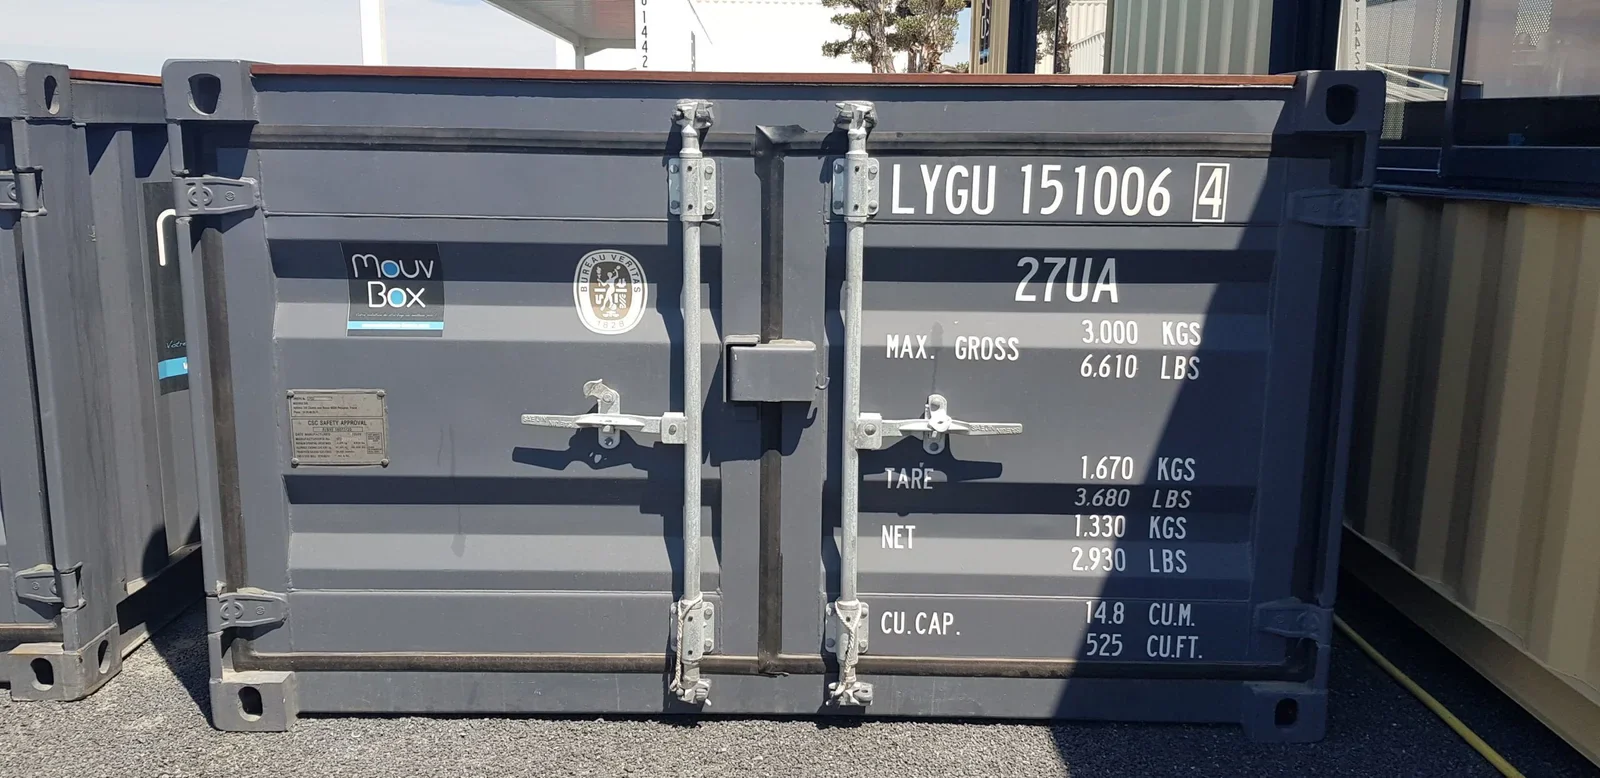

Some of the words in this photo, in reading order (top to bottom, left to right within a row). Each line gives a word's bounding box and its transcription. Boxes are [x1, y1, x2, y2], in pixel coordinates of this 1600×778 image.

[891, 164, 996, 215] LYGU
[1021, 165, 1172, 217] 151006
[1197, 166, 1225, 220] 4
[580, 254, 606, 293] BUREAU
[611, 254, 642, 293] VERITAS
[1015, 256, 1118, 303] 27UA
[367, 280, 426, 308] Box
[597, 320, 625, 329] 1828
[1081, 319, 1139, 345] 3,000
[1162, 321, 1201, 346] KGS
[886, 334, 935, 360] MAX.
[955, 336, 1020, 361] GROSS
[1080, 354, 1138, 380] 6,610
[1160, 355, 1200, 380] LBS
[885, 467, 934, 490] TARE
[1081, 456, 1134, 480] 1,670
[1157, 457, 1196, 482] KGS
[1074, 488, 1130, 508] 3,680
[1151, 489, 1193, 509] LBS
[881, 525, 916, 549] NET
[1149, 516, 1187, 540] KGS
[1149, 548, 1188, 573] LBS
[880, 611, 961, 636] CU.CAP.
[1085, 601, 1125, 625] 14.8
[1148, 603, 1196, 628] CU.M.
[1086, 634, 1123, 657] 525
[1146, 636, 1204, 660] CU.FT.
